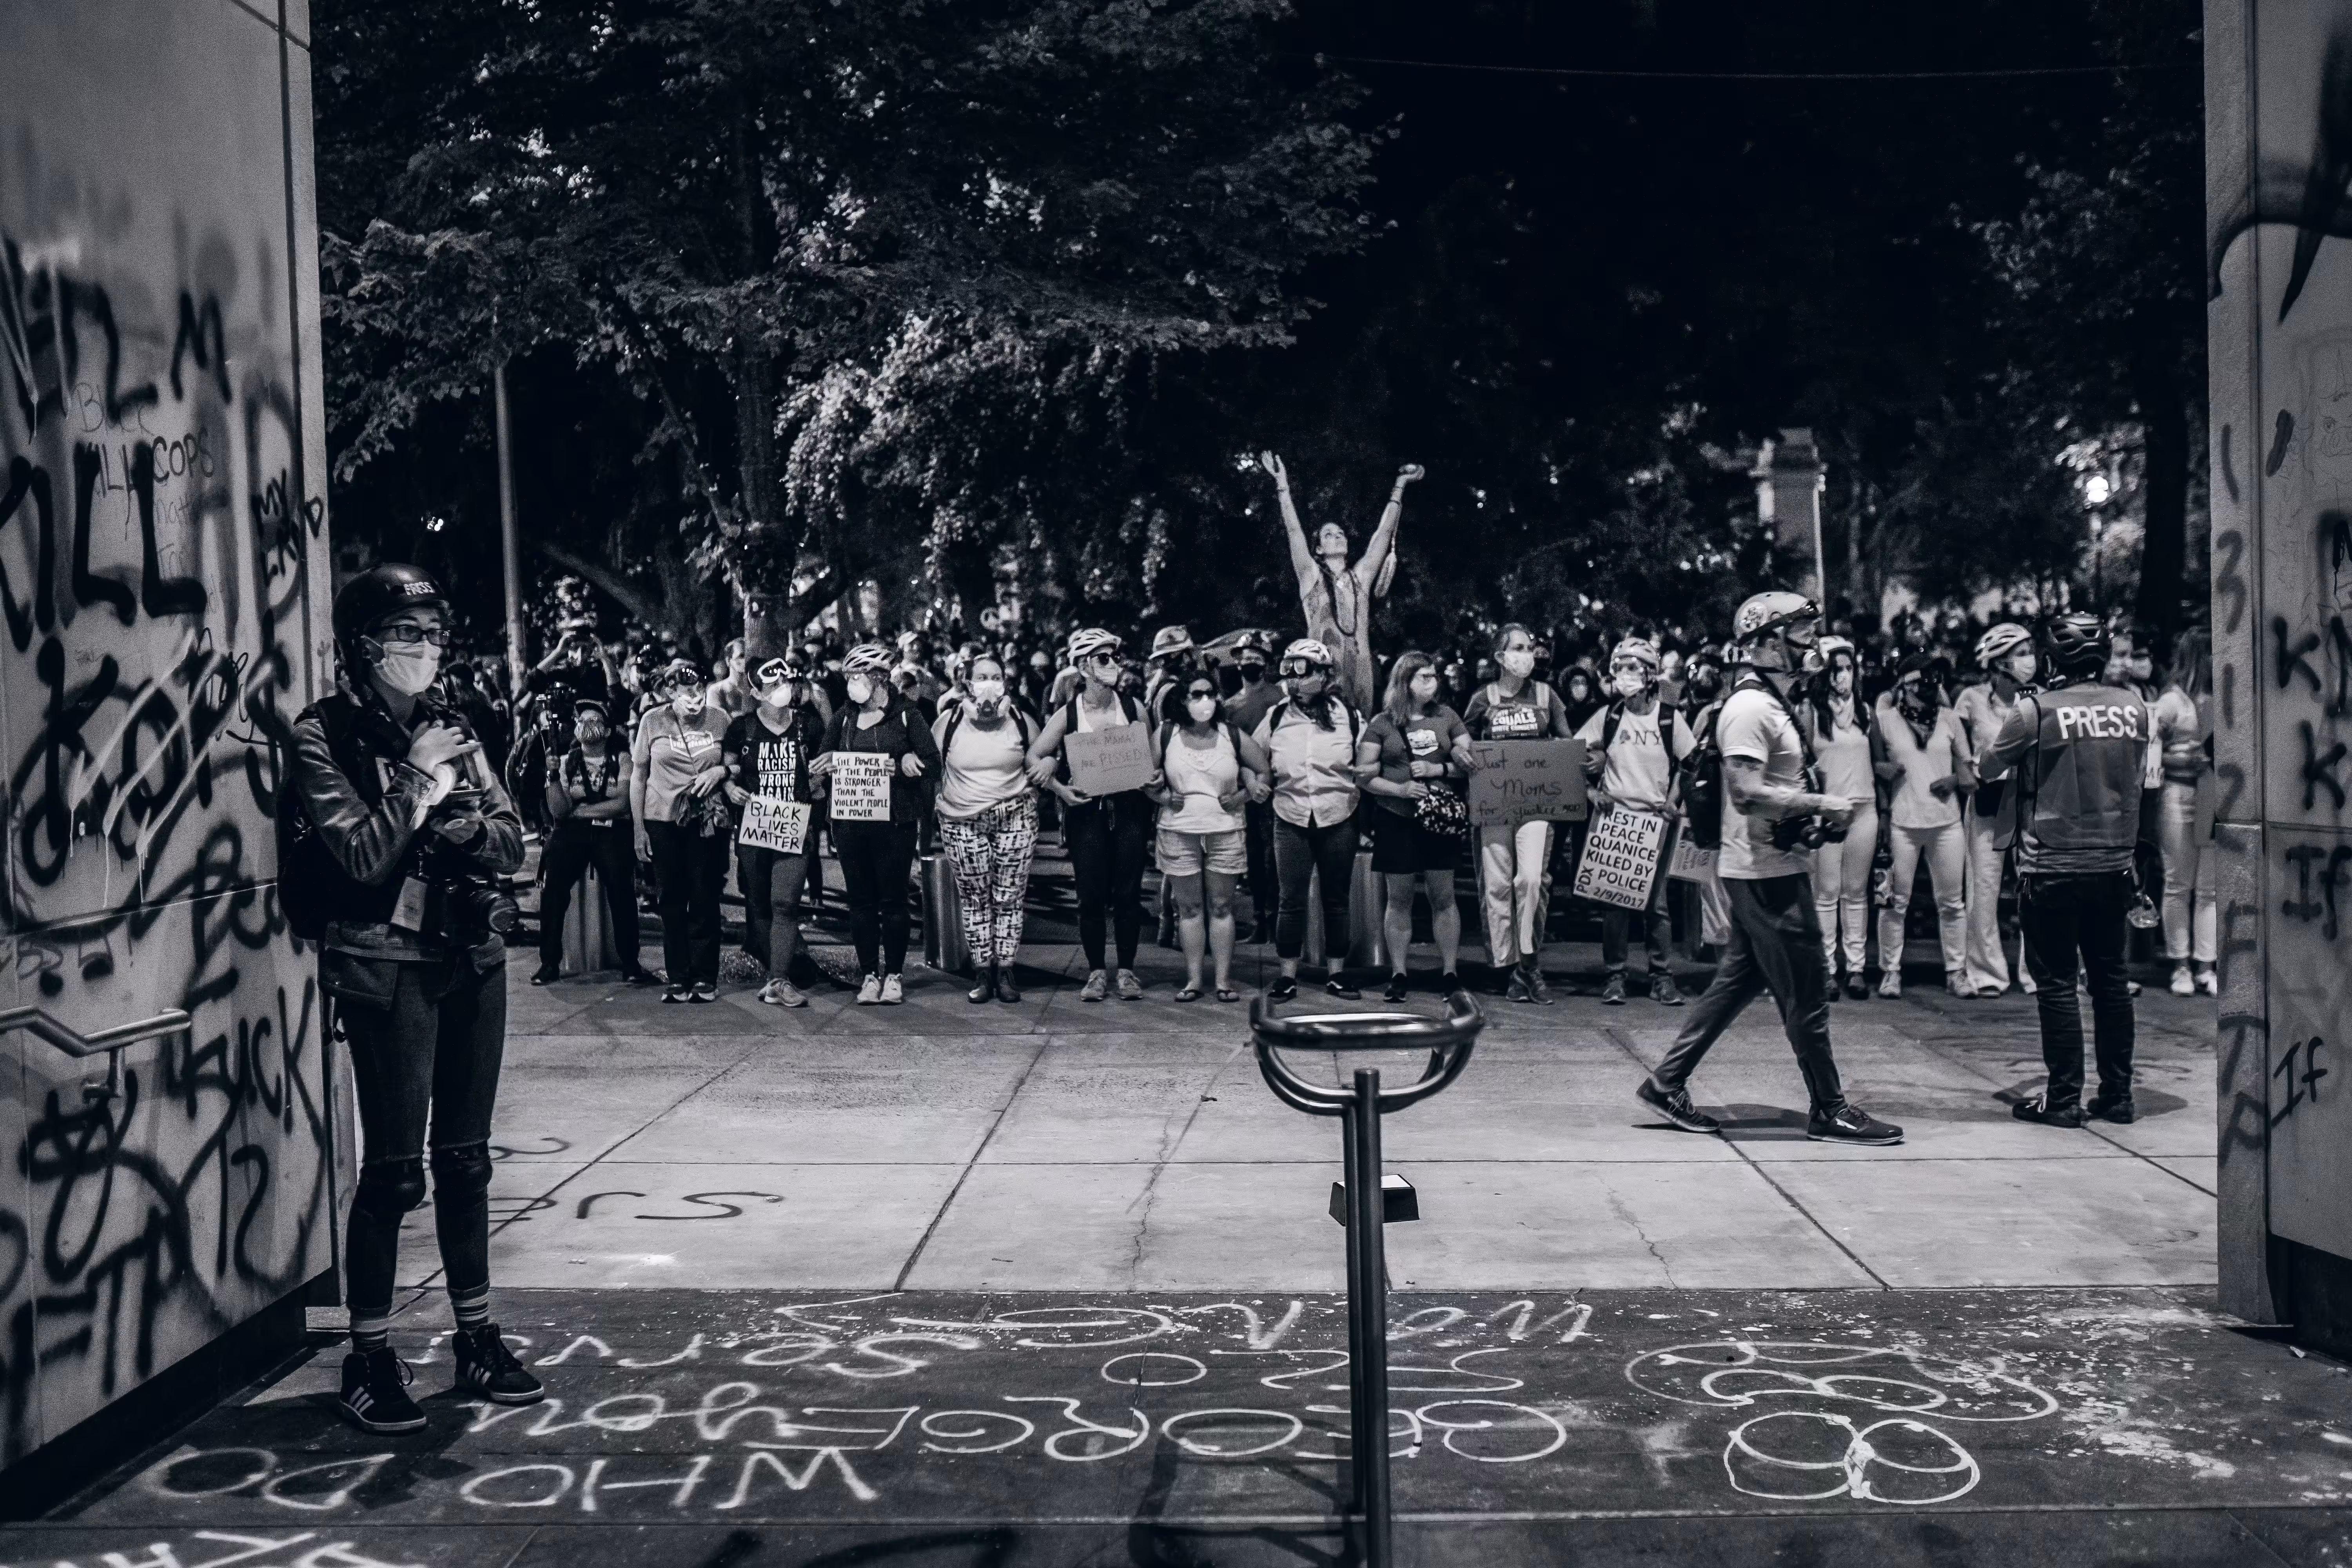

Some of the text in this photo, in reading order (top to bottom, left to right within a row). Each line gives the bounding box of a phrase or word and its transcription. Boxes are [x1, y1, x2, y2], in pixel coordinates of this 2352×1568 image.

[153, 428, 216, 485] COPS
[2056, 703, 2139, 740] PRESS
[758, 741, 796, 758] MAKE
[1475, 748, 1550, 770] Just one
[757, 757, 796, 771] RACISM
[836, 756, 880, 767] THE POWER
[759, 773, 795, 787] WRONG
[835, 777, 881, 788] IS STRONGER
[835, 788, 875, 797] THAN THE
[751, 801, 801, 822] BLACK
[834, 799, 888, 808] VIOLENT PEOPLE
[849, 809, 873, 817] POWER
[1477, 800, 1498, 817] for
[758, 818, 799, 837] LIVES
[1601, 822, 1646, 844] PEACE
[1641, 818, 1657, 833] IN
[743, 827, 800, 850] MATTER
[1590, 835, 1657, 862] QUANICE
[1586, 848, 1653, 878] KILLED BY
[1576, 865, 1595, 894] PDX
[1598, 868, 1649, 893] POLICE
[1593, 886, 1645, 908] 2/9/2017
[742, 1396, 1568, 1462] GEORGE
[144, 1446, 880, 1513] WHO DO
